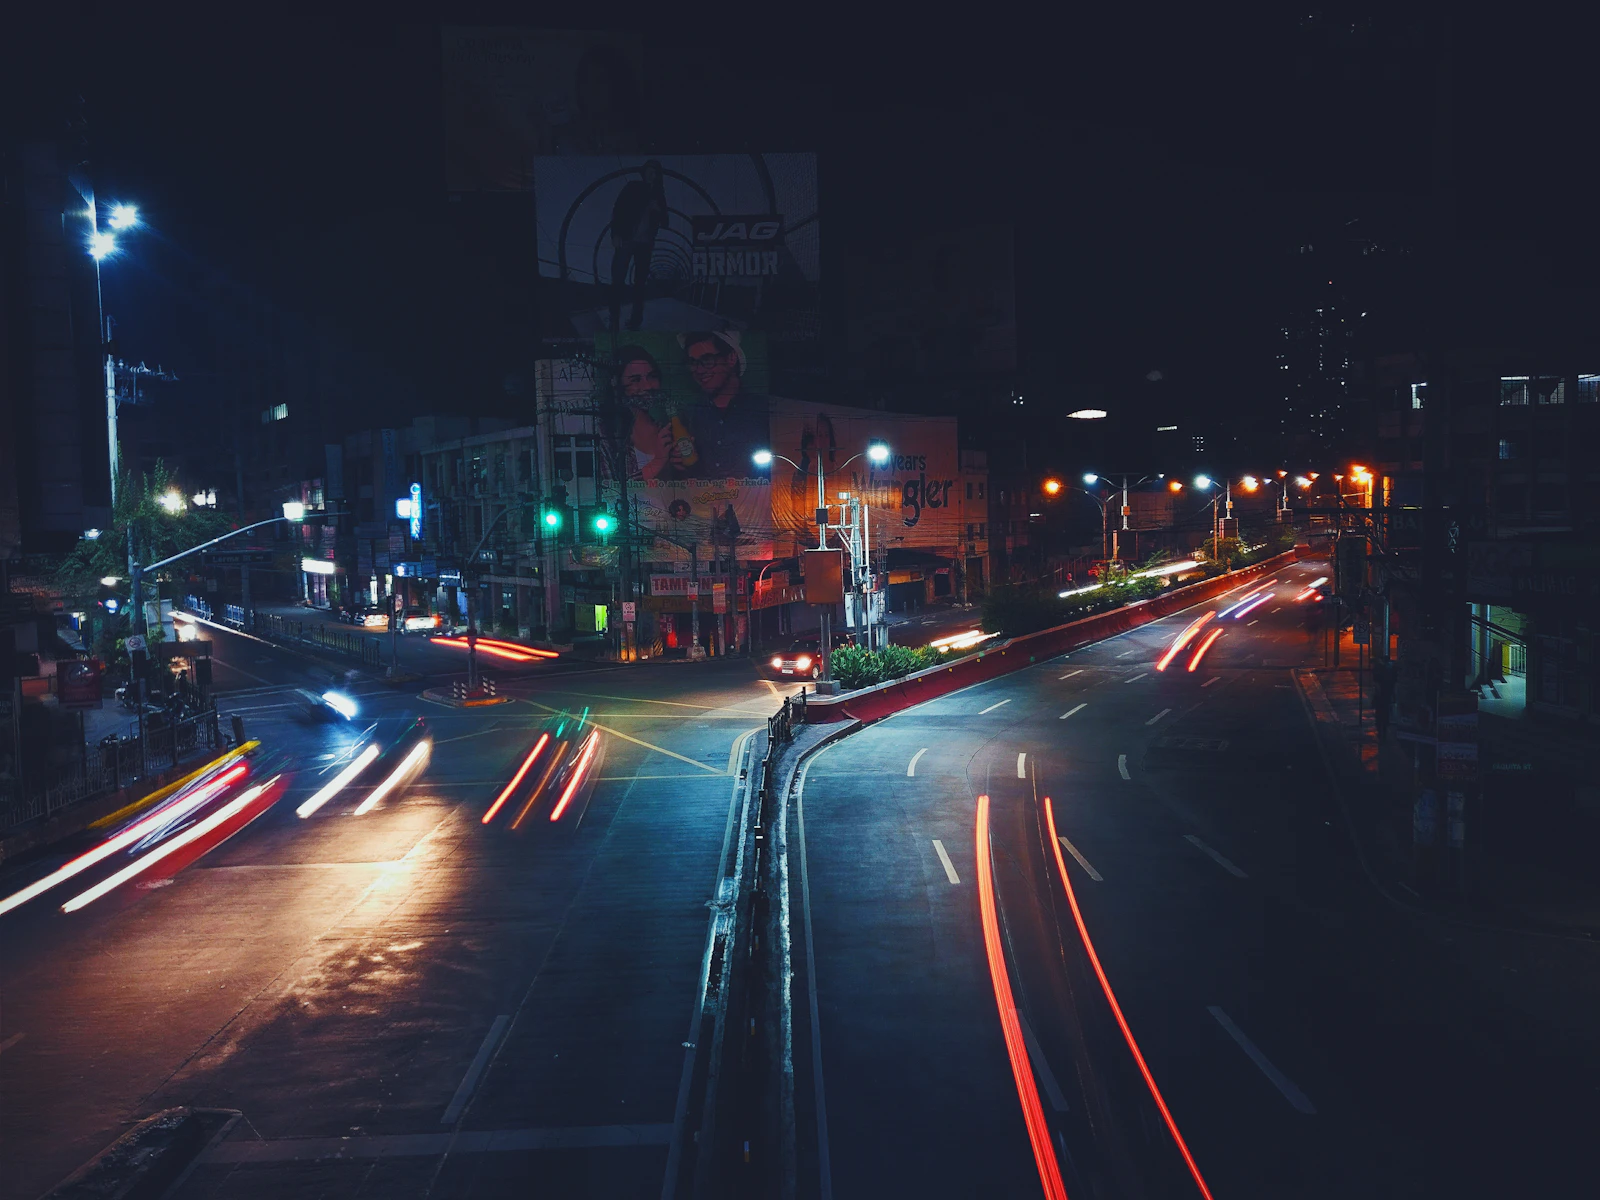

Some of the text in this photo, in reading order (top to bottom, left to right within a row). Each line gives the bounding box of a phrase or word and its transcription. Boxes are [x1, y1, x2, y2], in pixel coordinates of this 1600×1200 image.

[697, 221, 780, 241] JAG
[692, 250, 779, 276] ARMOR
[890, 455, 927, 476] years
[851, 472, 954, 527] Wrangler
